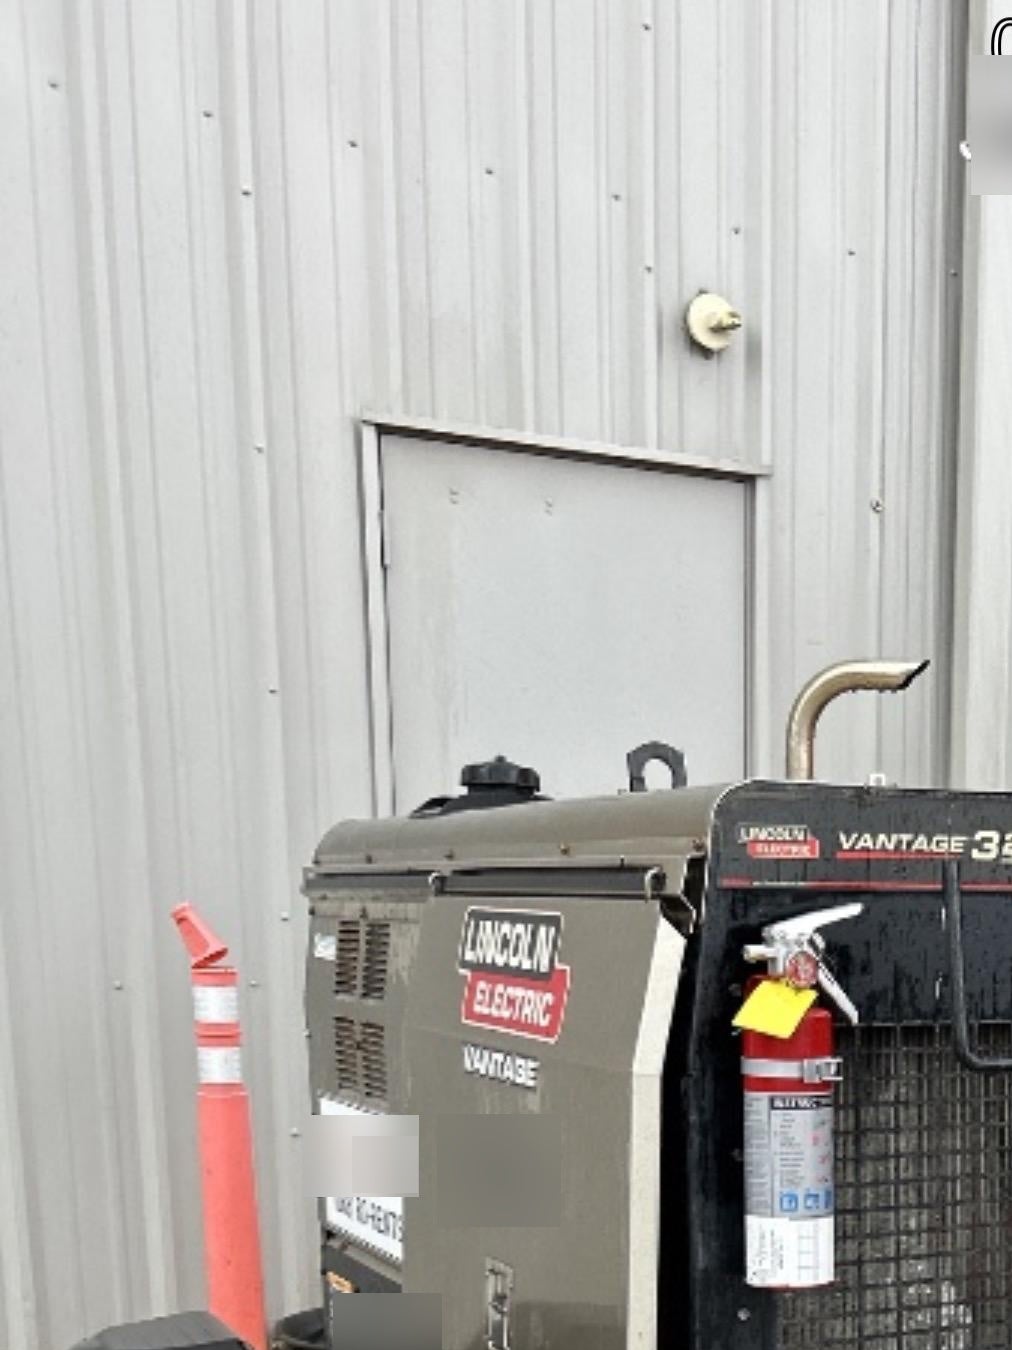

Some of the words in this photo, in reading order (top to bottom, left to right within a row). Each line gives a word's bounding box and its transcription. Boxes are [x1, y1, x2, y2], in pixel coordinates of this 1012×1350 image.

[839, 831, 968, 853] VANTAGE
[464, 919, 555, 973] LINCOLN
[472, 979, 554, 1028] ELECTRIC
[463, 1044, 541, 1088] VANTAGE
